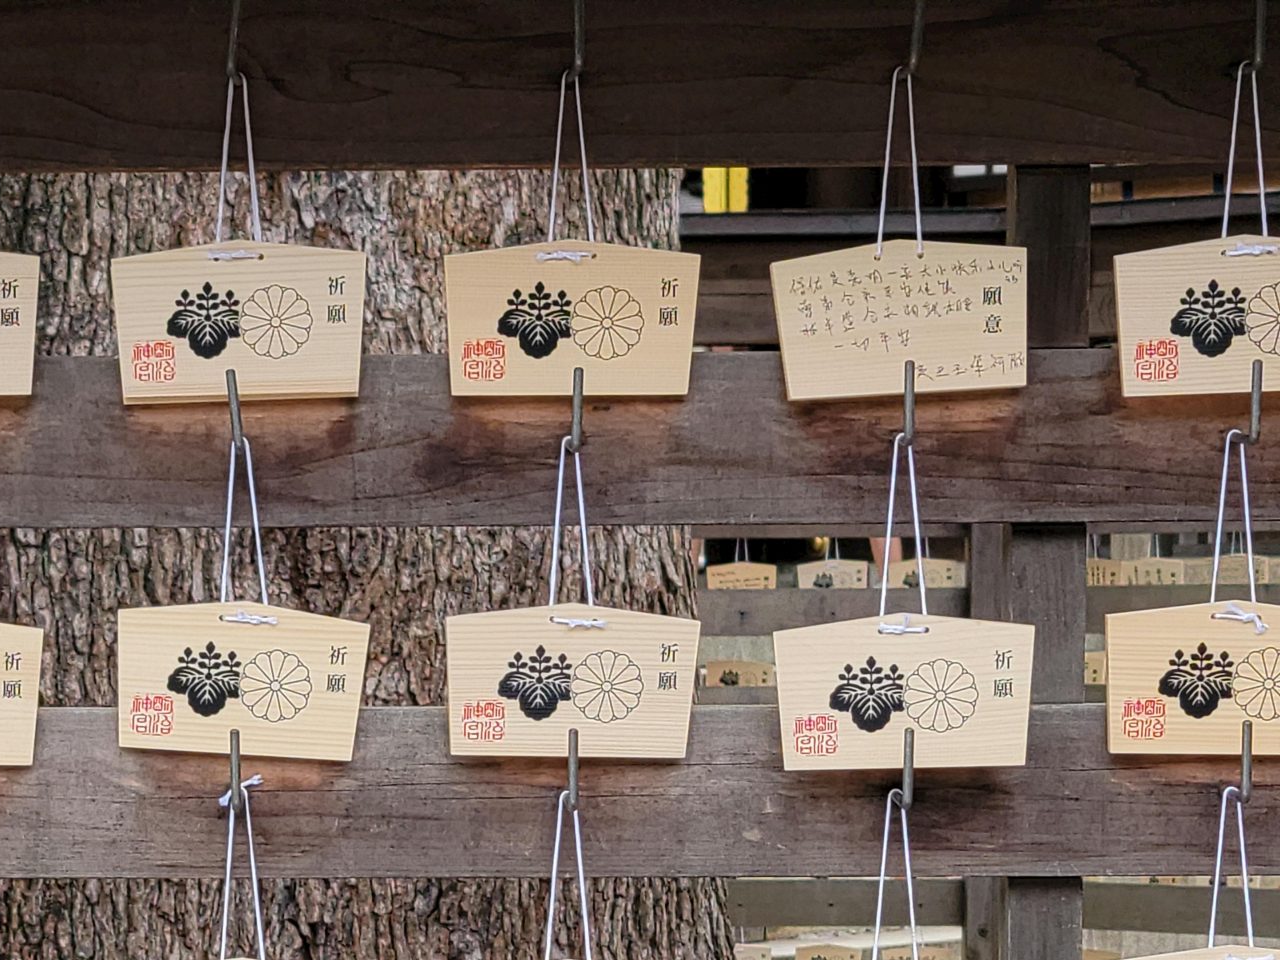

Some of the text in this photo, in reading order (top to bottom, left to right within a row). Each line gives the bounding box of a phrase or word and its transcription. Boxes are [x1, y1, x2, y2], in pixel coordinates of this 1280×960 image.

[0, 278, 20, 327] 祈願
[327, 275, 347, 324] 祈願
[658, 278, 679, 326] 祈願
[982, 286, 1003, 334] 願意
[2, 651, 22, 699] 祈願
[326, 645, 348, 693] 祈願
[657, 643, 679, 691] 祈願
[993, 649, 1014, 698] 祈願
